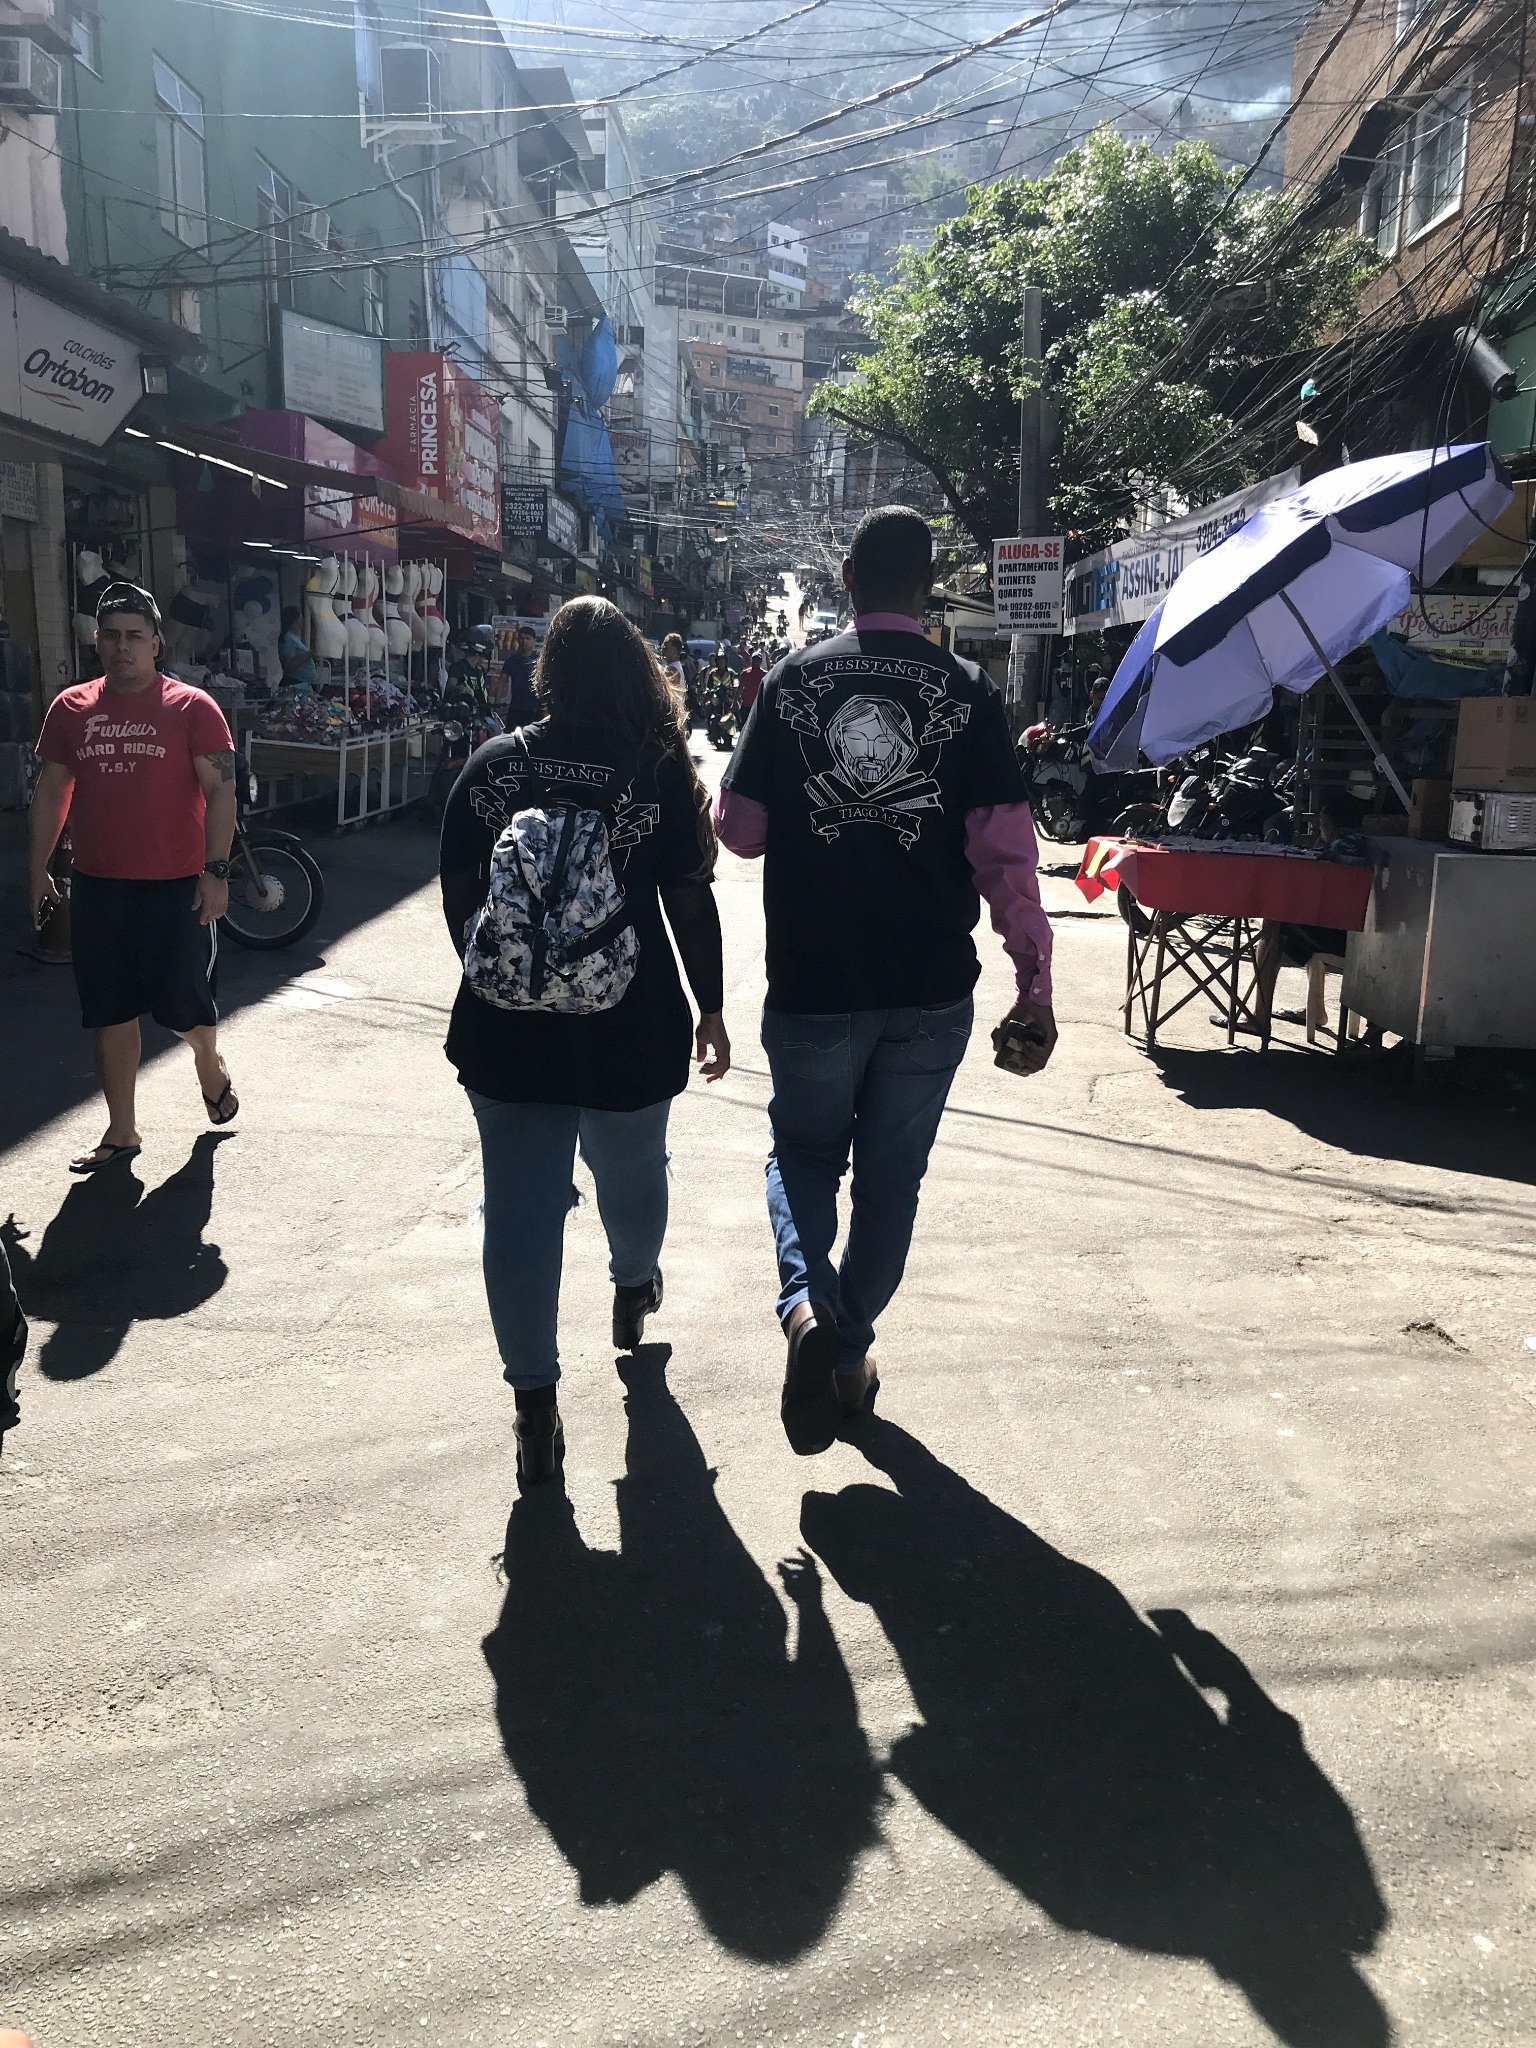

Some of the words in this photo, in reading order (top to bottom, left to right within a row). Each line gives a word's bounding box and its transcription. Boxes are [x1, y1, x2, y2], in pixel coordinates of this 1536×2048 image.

[24, 348, 115, 404] Ortobom
[419, 371, 439, 475] PRINCESA
[998, 543, 1060, 560] ALUGA-SE
[998, 562, 1059, 573] APARTAMENTOS
[998, 575, 1036, 586] KITINETES
[998, 588, 1033, 599] QUARTOS
[824, 660, 929, 680] RESISTANCE
[84, 714, 157, 743] Furious
[76, 743, 116, 760] HARD
[123, 743, 167, 759] RIDER
[839, 807, 879, 819] TIAGO
[881, 812, 898, 824] 4:7
